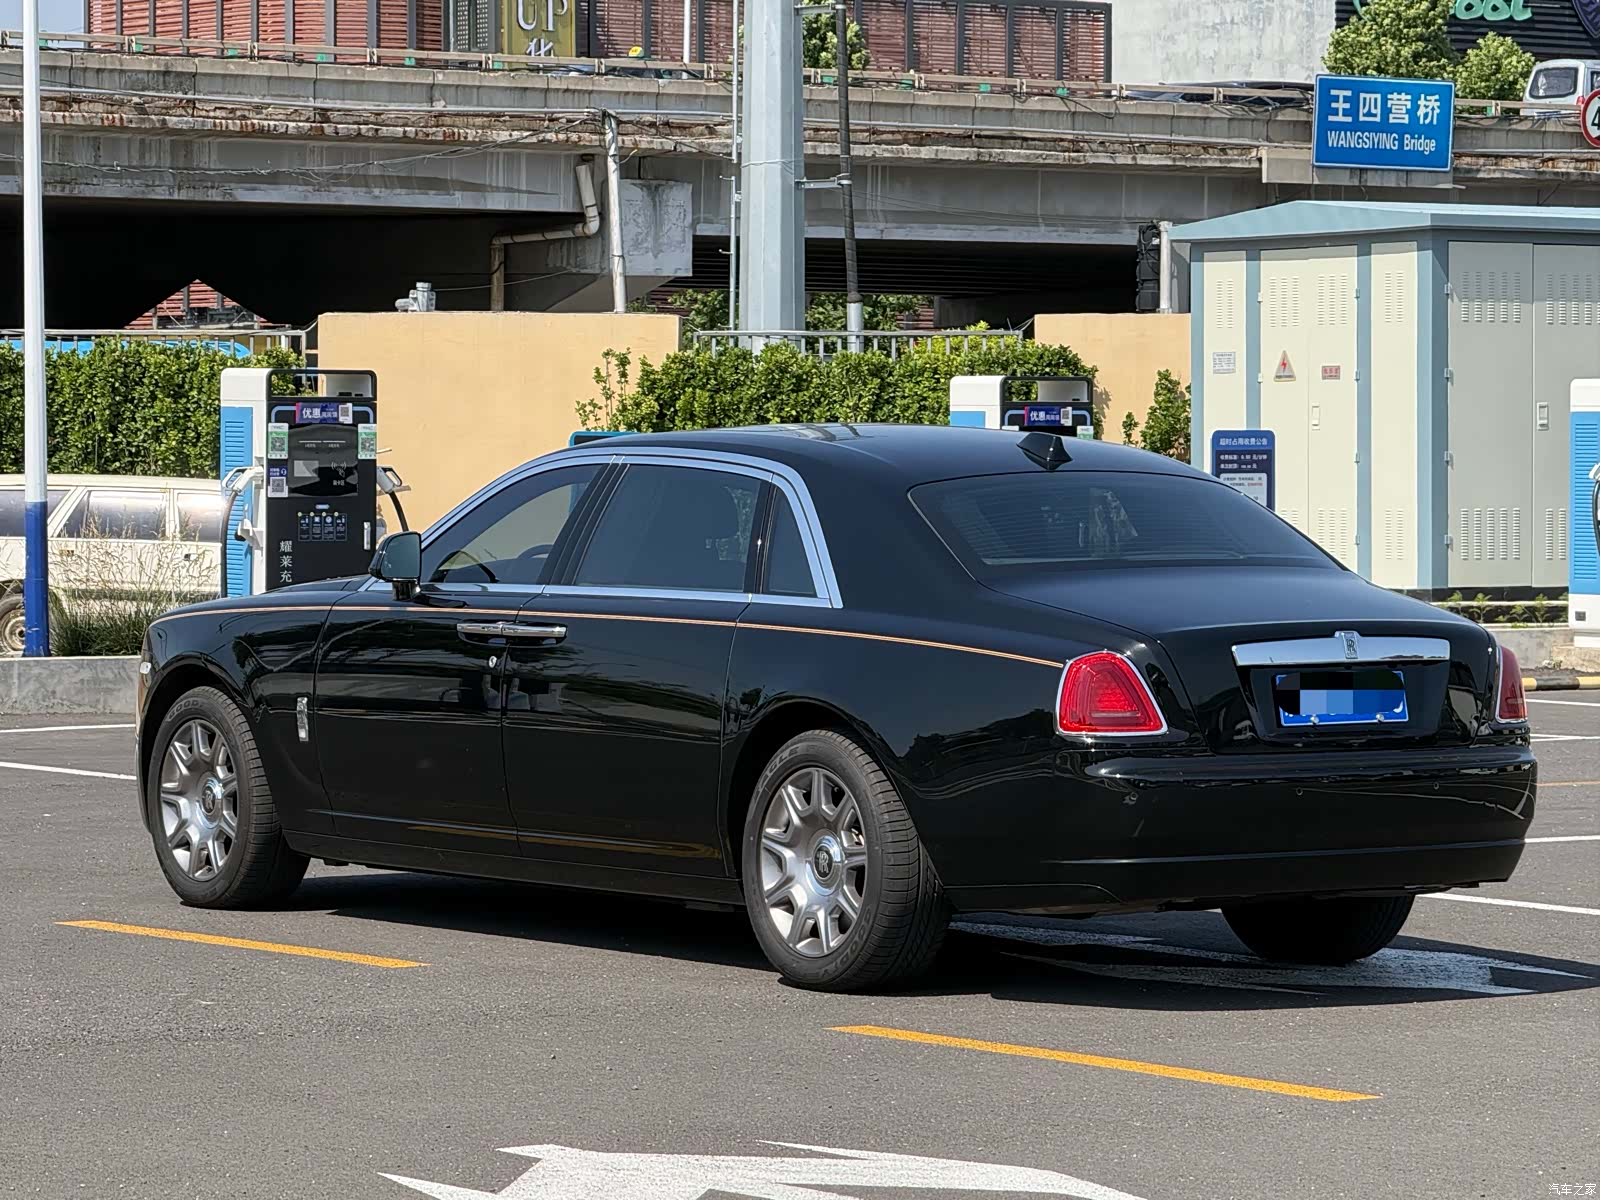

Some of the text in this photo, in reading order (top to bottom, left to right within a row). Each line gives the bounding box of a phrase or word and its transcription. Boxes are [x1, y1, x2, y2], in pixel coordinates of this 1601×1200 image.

[1328, 89, 1441, 125] 王四营桥
[1327, 131, 1436, 155] WANGSIYING Bridge
